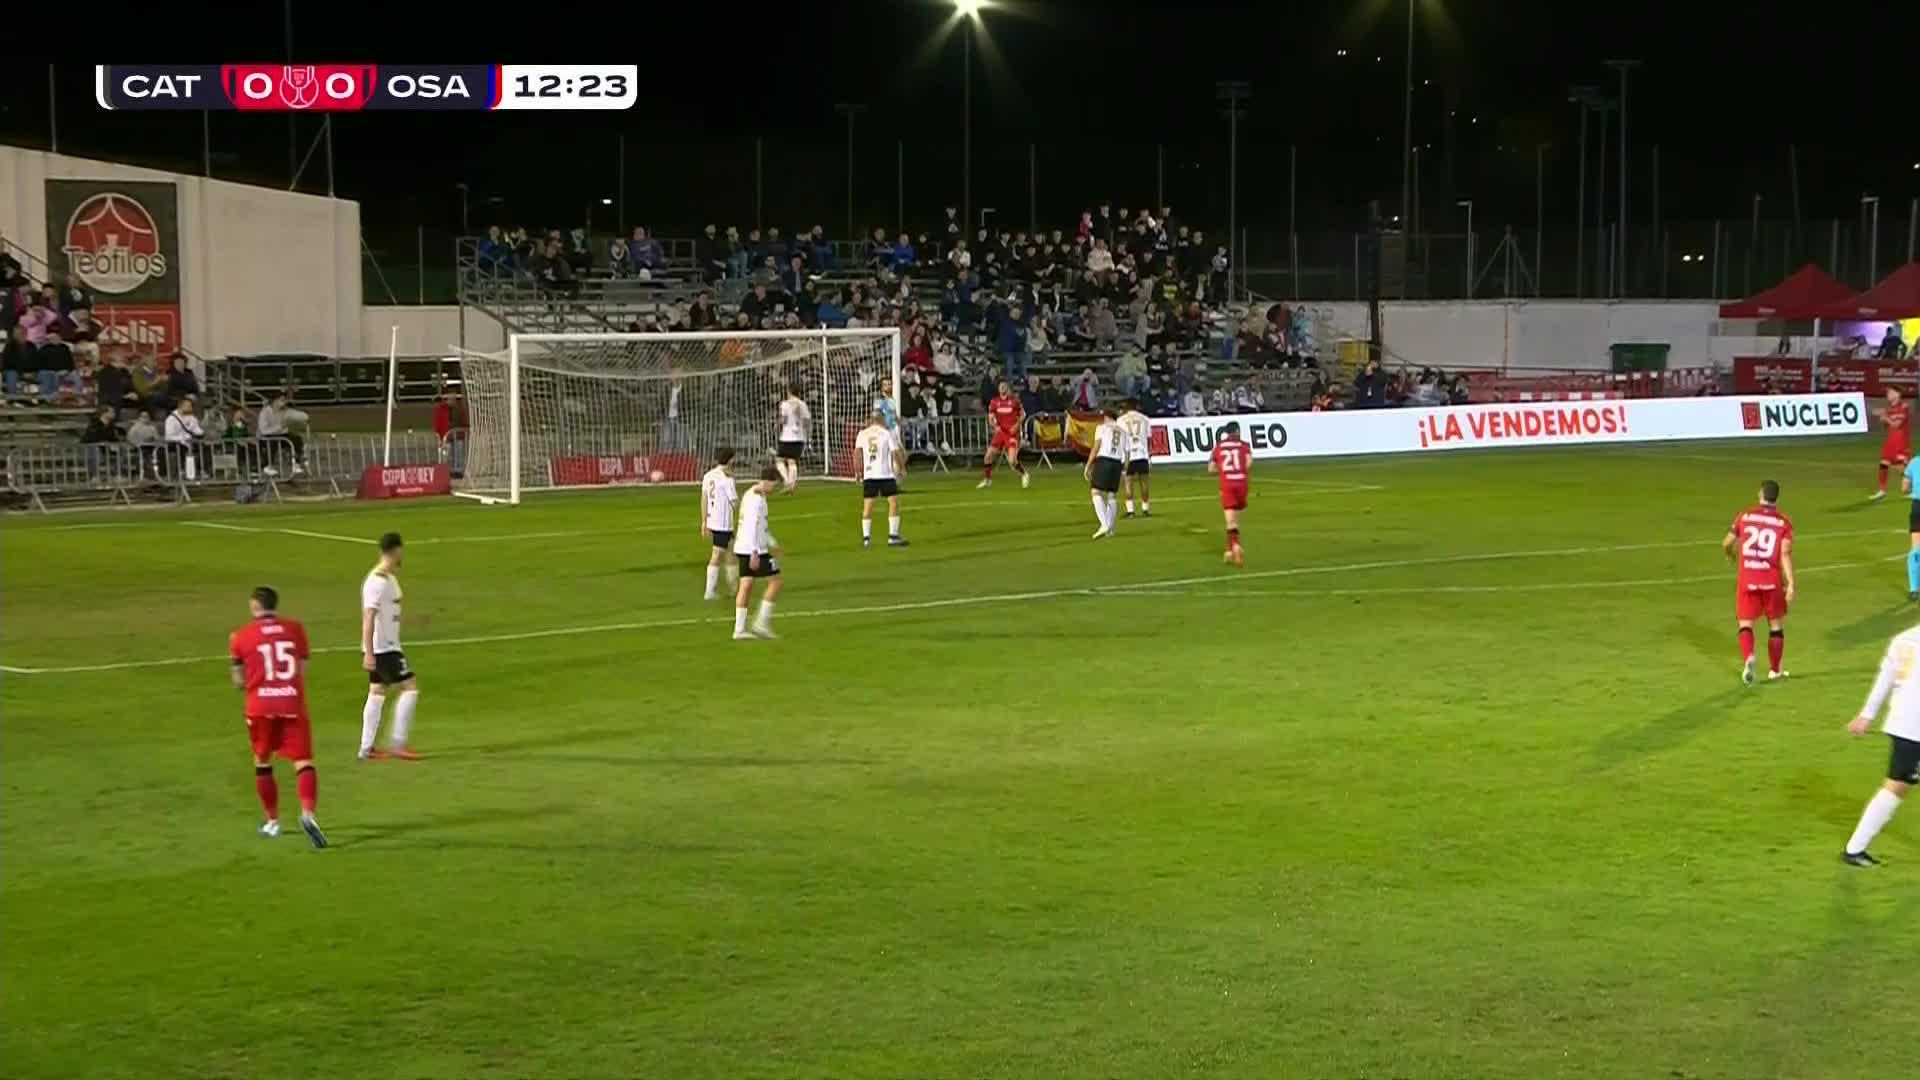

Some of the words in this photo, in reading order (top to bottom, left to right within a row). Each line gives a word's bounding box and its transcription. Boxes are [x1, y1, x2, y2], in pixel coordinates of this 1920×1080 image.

[1419, 413, 1464, 448] ¡LA
[1467, 406, 1628, 439] VENDEMOS!
[1765, 400, 1859, 428] NÚCLEO
[1173, 422, 1287, 454] NÚEO
[383, 469, 407, 486] COPA
[418, 466, 434, 483] REY
[1220, 449, 1241, 472] 21
[1743, 525, 1777, 558] 29
[257, 640, 295, 681] 15
